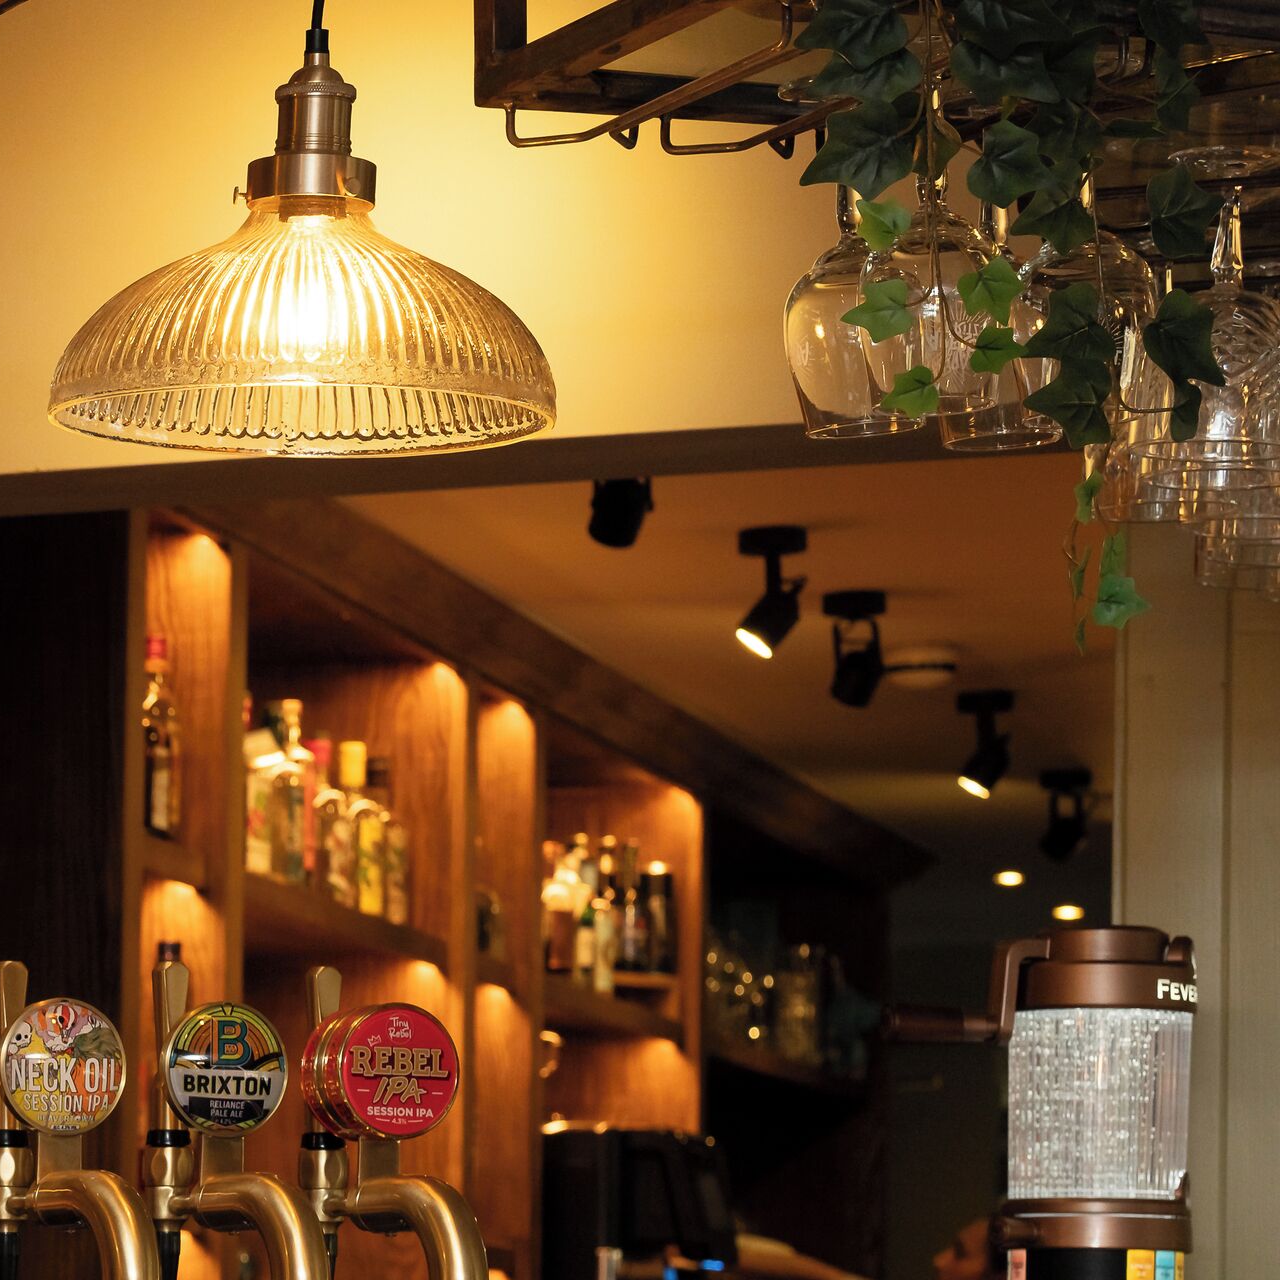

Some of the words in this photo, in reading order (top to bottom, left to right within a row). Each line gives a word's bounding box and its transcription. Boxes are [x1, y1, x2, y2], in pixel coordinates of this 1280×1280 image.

[389, 1016, 409, 1029] Tiny
[210, 1015, 252, 1067] B
[388, 1028, 412, 1039] Rebel
[350, 1045, 449, 1078] REBEL
[11, 1057, 77, 1093] NECK
[84, 1057, 119, 1093] OIL
[183, 1074, 272, 1096] BRIXTON
[372, 1076, 428, 1105] IPA
[23, 1094, 83, 1113] SESSION
[87, 1094, 109, 1112] IPA
[209, 1099, 245, 1110] RELIANCE
[367, 1106, 414, 1117] SESSION
[416, 1108, 434, 1118] IPA
[210, 1109, 228, 1118] PALE
[229, 1110, 243, 1118] ALE
